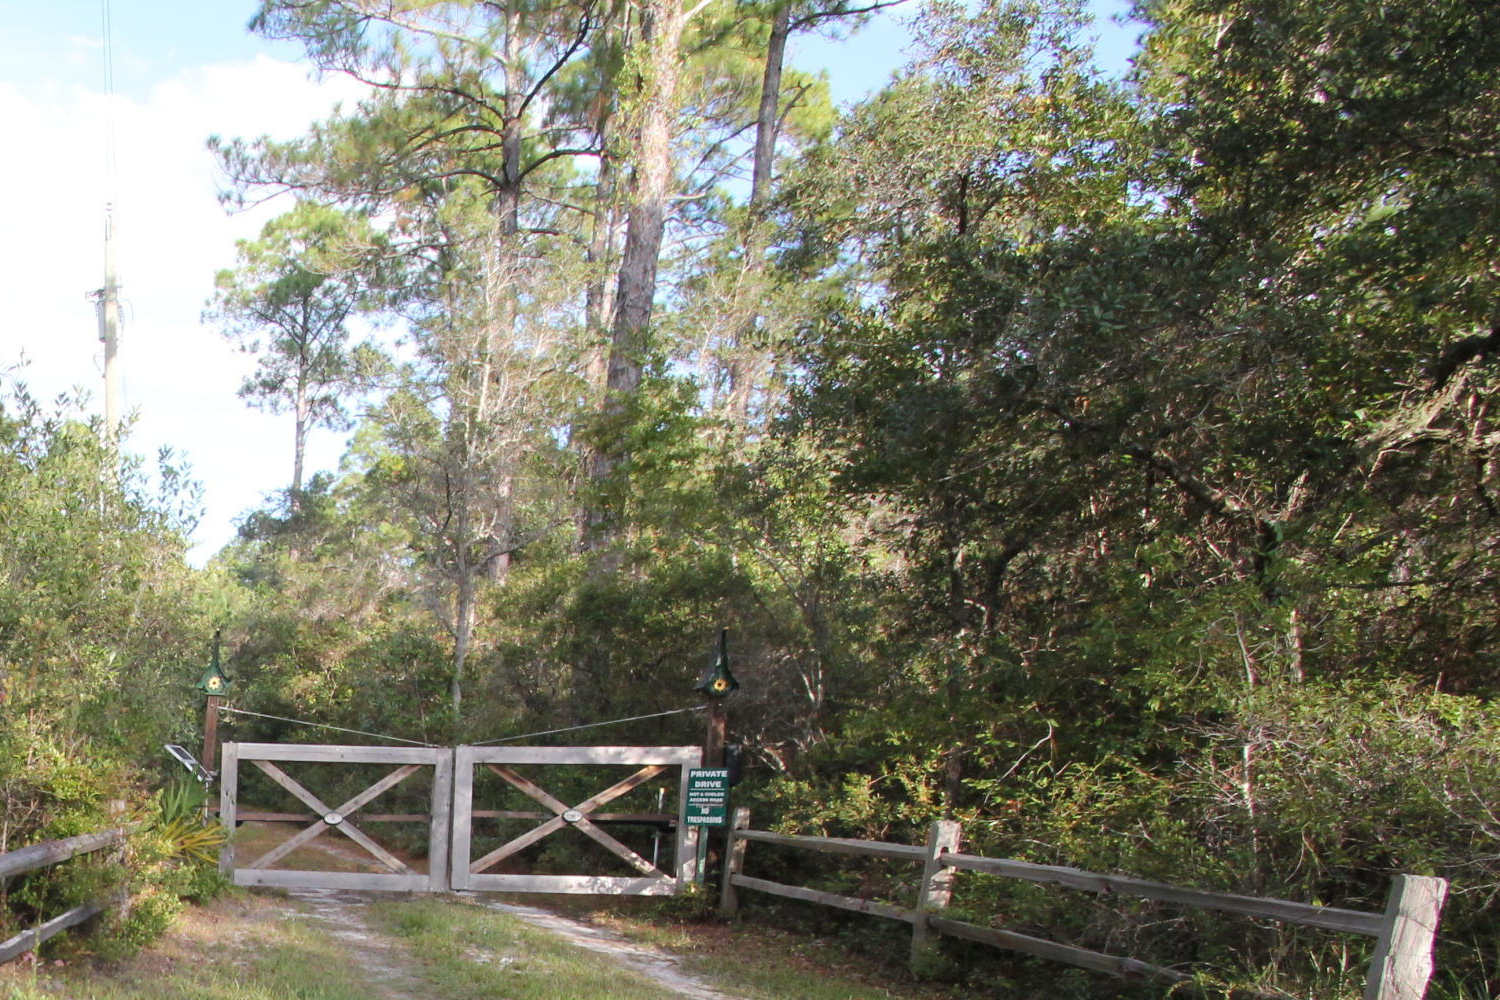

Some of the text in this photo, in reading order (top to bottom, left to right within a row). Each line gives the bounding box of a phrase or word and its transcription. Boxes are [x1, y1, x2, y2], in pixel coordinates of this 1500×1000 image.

[690, 770, 728, 778] PRIVATE
[695, 780, 722, 788] DRIVE
[687, 816, 722, 824] TRESPASSING
